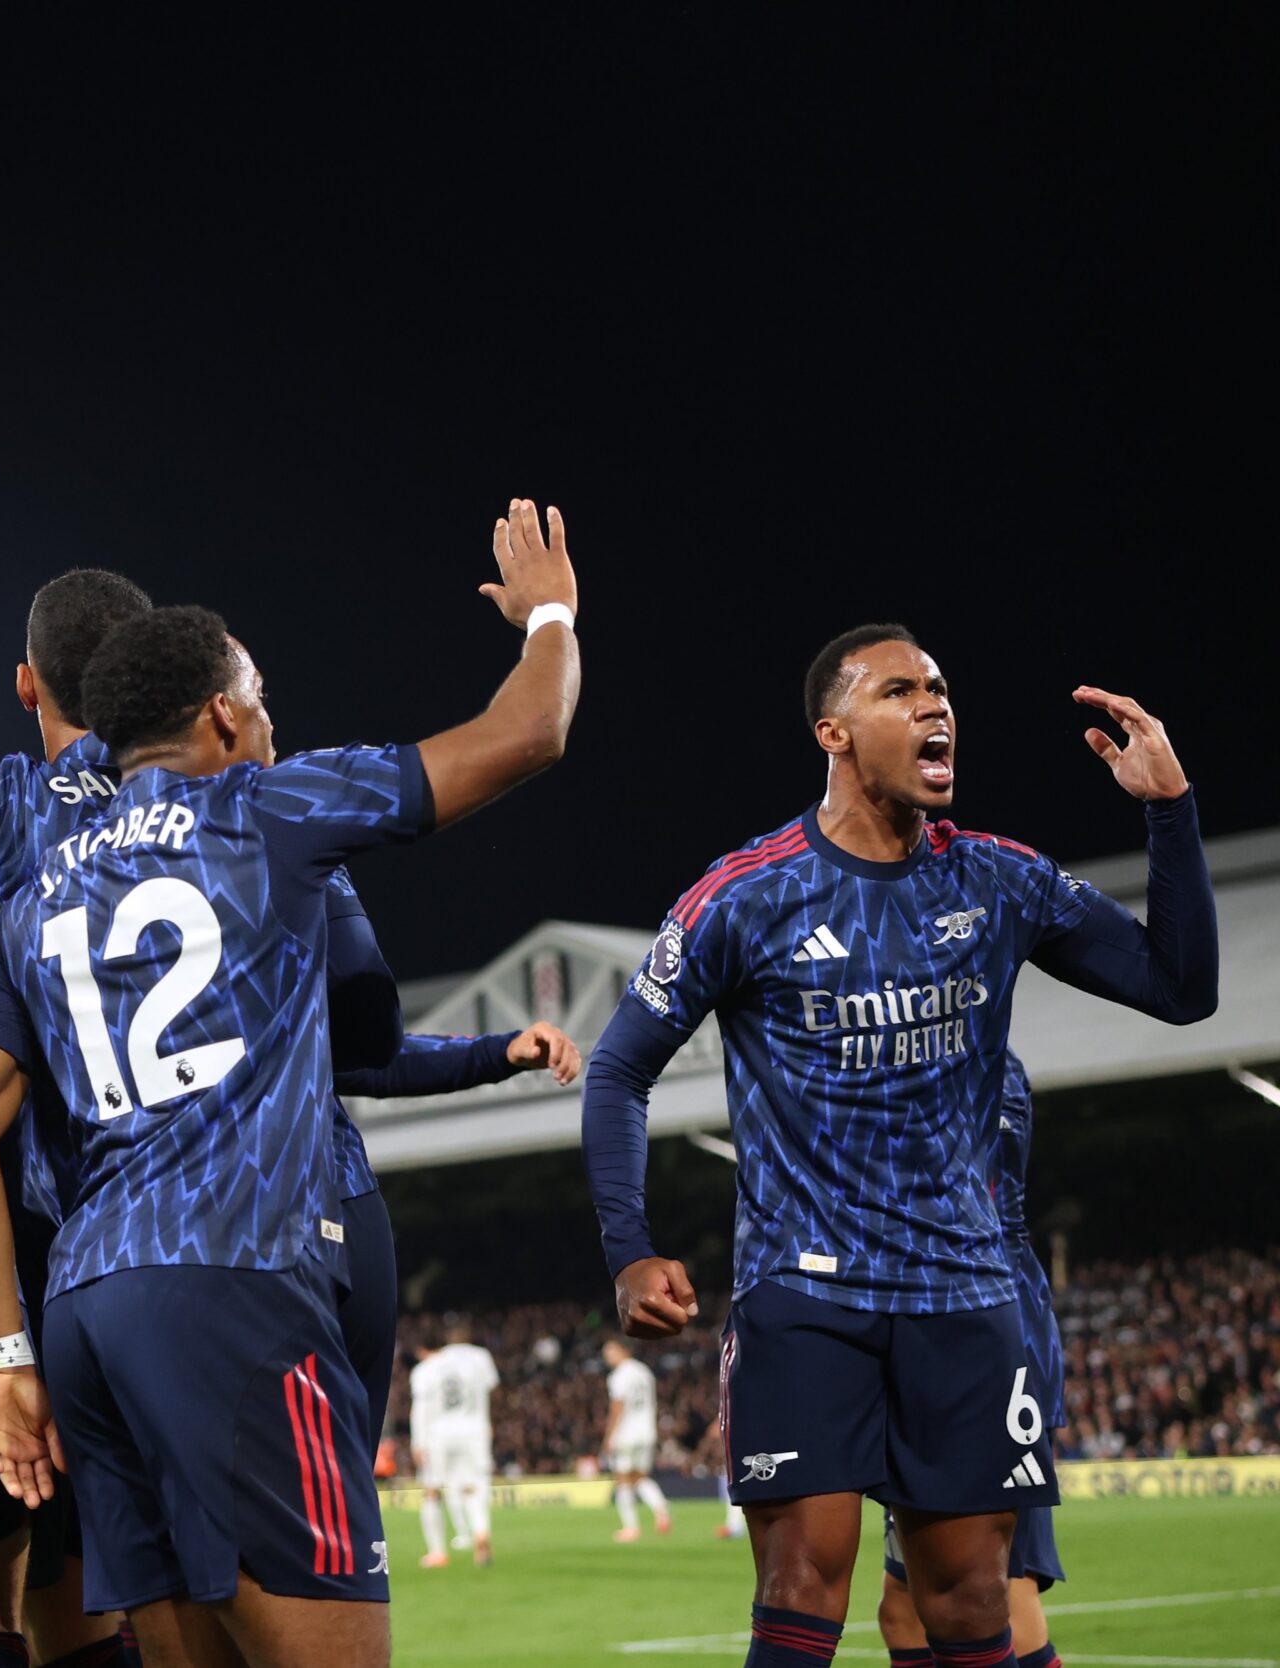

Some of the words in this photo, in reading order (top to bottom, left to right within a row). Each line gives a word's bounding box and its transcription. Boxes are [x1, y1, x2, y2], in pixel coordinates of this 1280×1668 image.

[57, 802, 195, 870] TIMBER
[41, 877, 247, 1121] 12
[644, 979, 668, 1003] room
[798, 972, 989, 1032] Emirates
[840, 1034, 884, 1070] FLY
[893, 1019, 966, 1066] BETTER
[1005, 1366, 1042, 1445] 6
